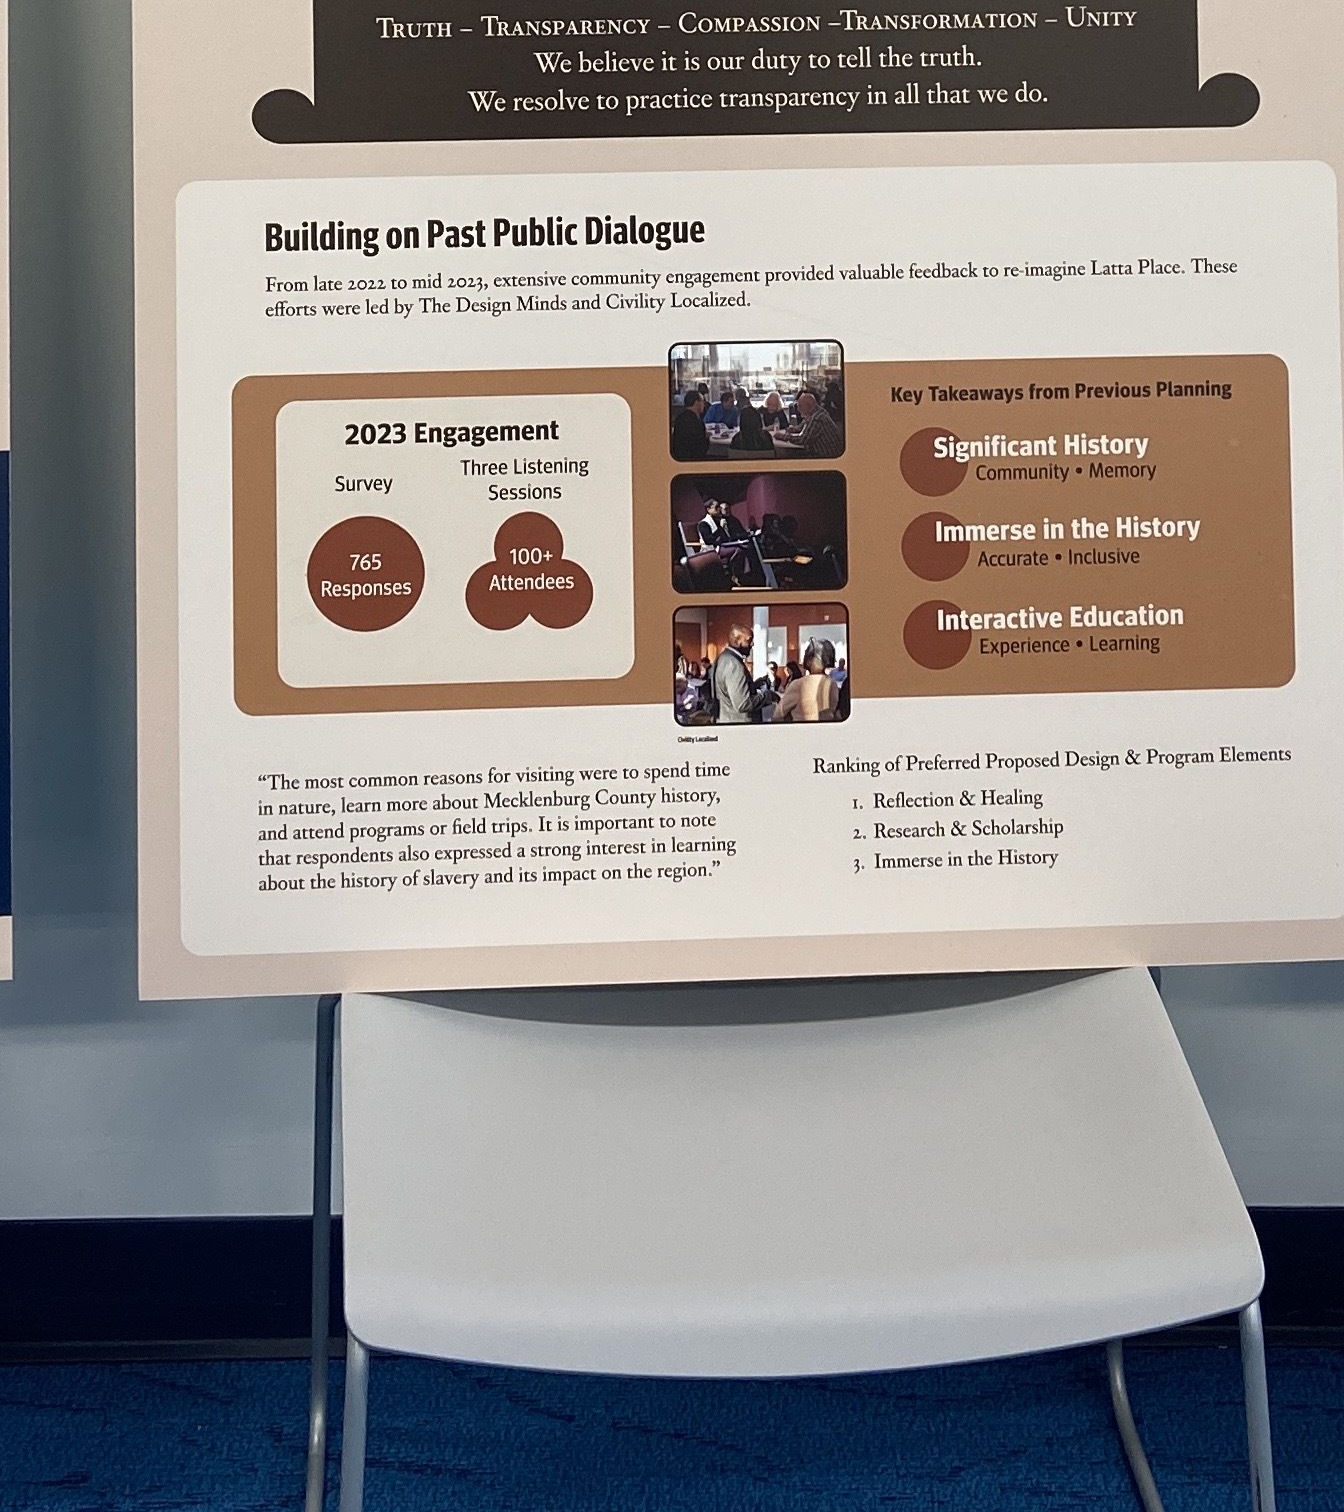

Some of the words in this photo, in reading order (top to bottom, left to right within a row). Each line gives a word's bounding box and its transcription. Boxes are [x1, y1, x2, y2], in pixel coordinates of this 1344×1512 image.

[264, 219, 380, 257] Building
[384, 225, 420, 250] on
[426, 218, 487, 249] Past
[492, 214, 578, 247] Public
[584, 213, 705, 251] Dialogue
[344, 421, 407, 446] 2023
[413, 419, 560, 448] Engagement
[459, 458, 508, 476] Three
[512, 455, 589, 477] Listening
[333, 474, 393, 495] Survey
[487, 482, 562, 501] Sessions
[349, 552, 382, 571] 765
[508, 546, 553, 565] 100+
[320, 579, 412, 600] Responses
[487, 571, 575, 591] Attendees
[873, 790, 954, 809] Reflection
[958, 789, 976, 807] &
[979, 787, 1044, 810] Healing
